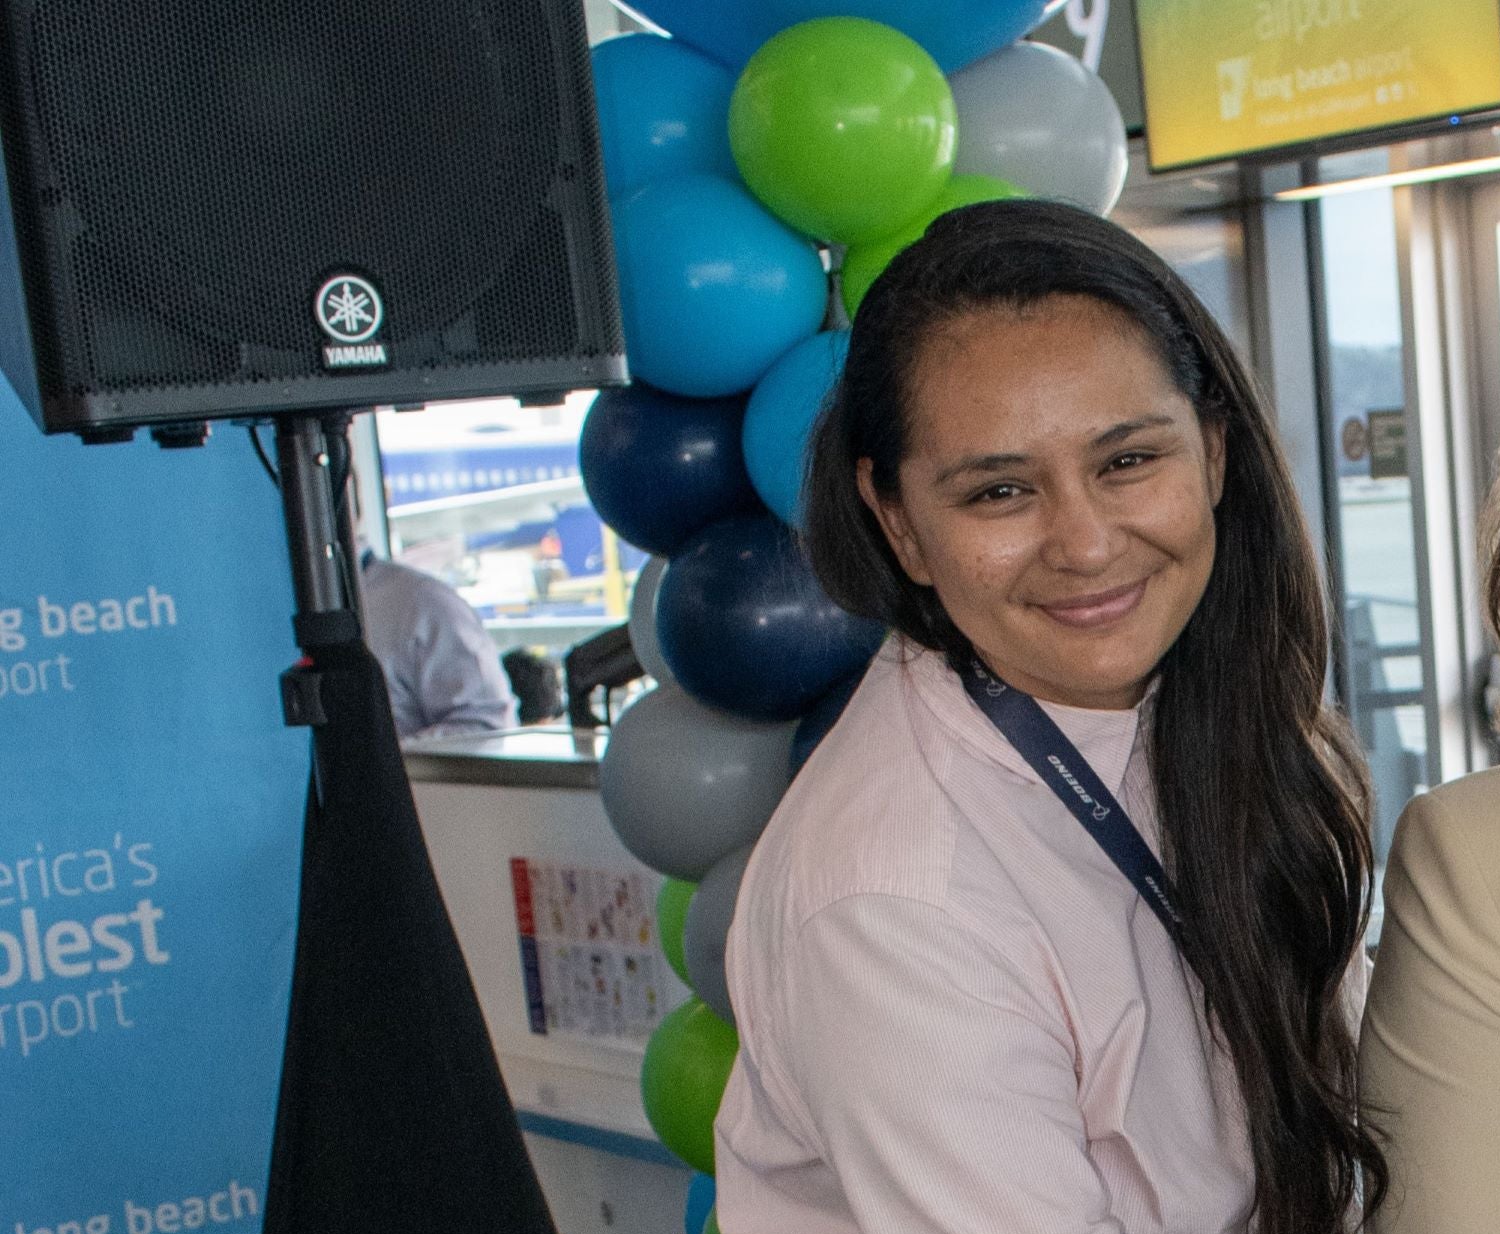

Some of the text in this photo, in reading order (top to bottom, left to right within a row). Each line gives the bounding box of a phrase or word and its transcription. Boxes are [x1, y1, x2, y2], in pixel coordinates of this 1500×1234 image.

[325, 345, 387, 367] YAMAHA
[37, 585, 177, 638] beach
[1047, 754, 1095, 804] BOEING
